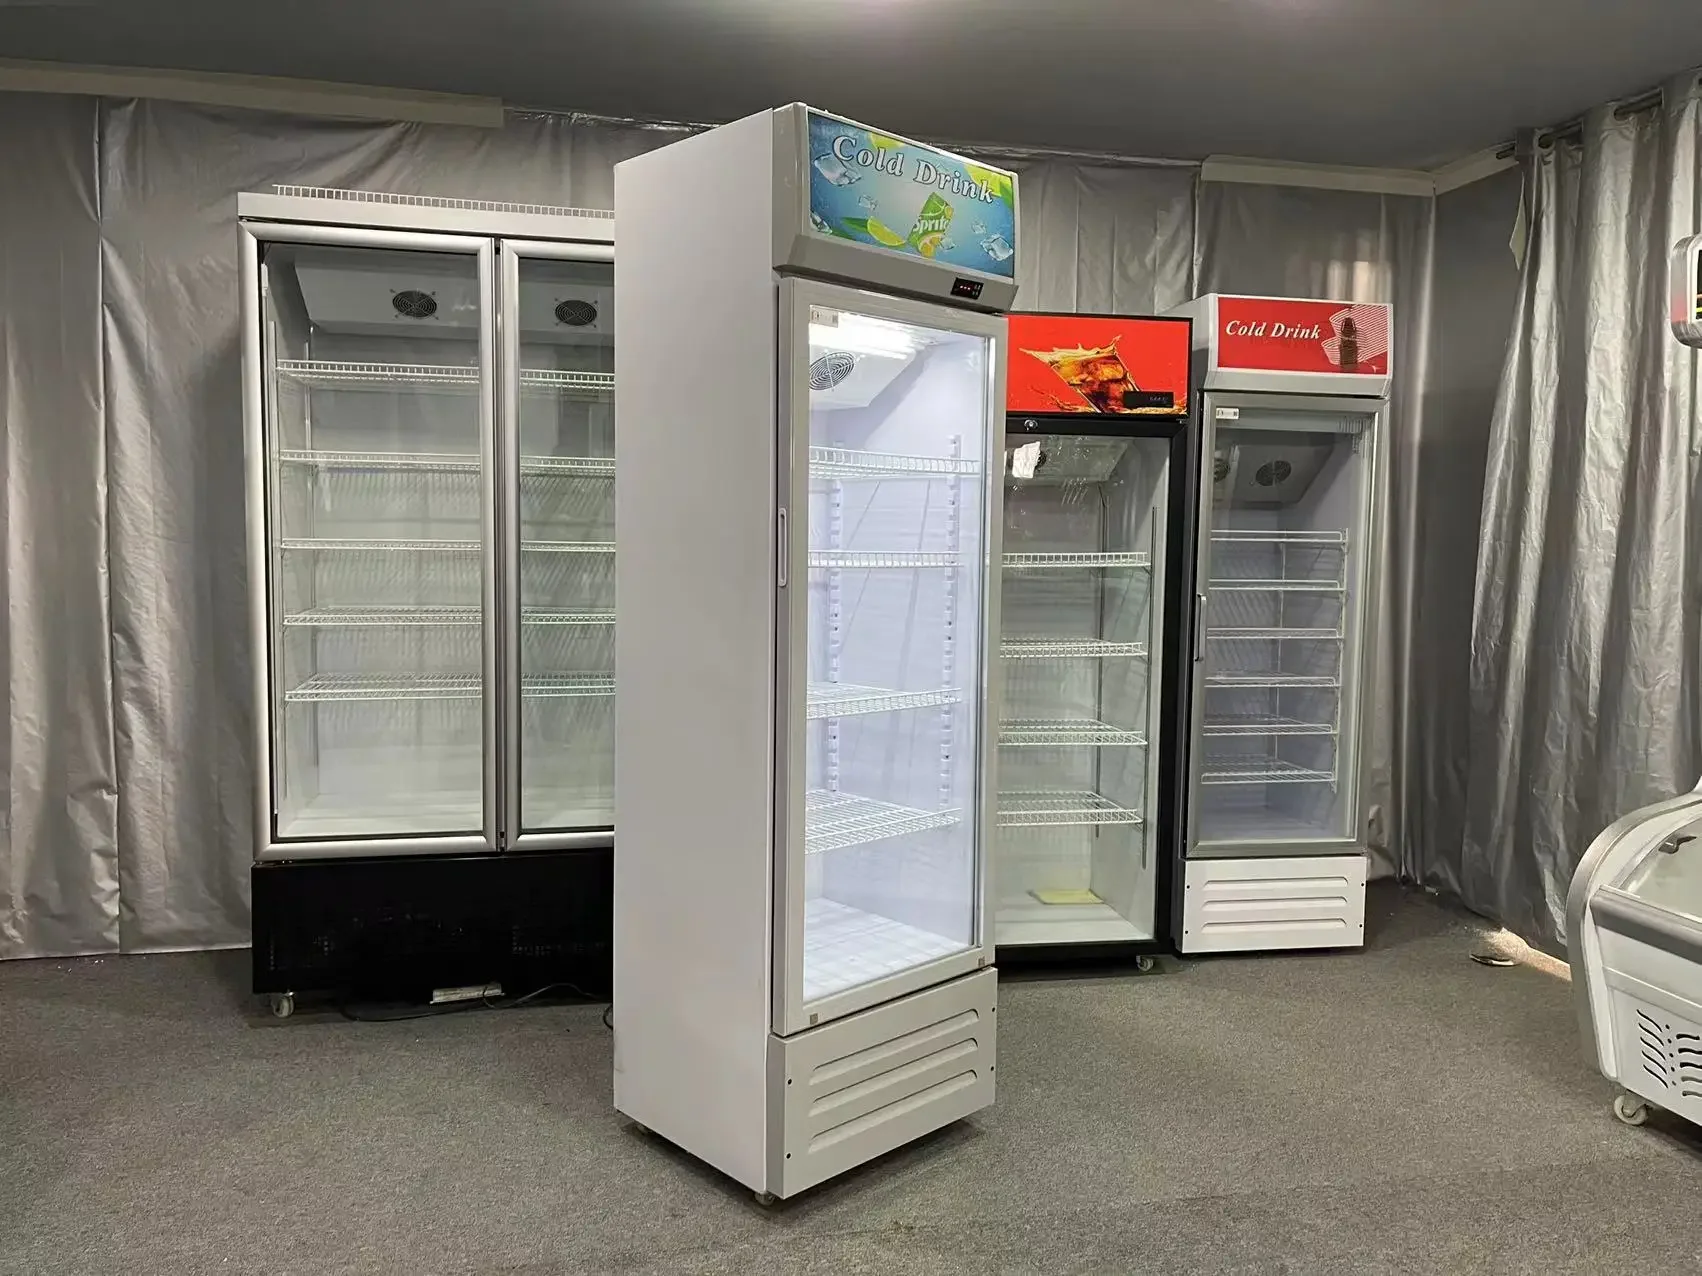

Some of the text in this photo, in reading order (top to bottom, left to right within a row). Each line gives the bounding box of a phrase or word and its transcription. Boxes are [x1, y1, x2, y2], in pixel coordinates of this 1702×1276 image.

[832, 135, 994, 203] Cold Drink
[1225, 320, 1322, 340] Cold Drink
